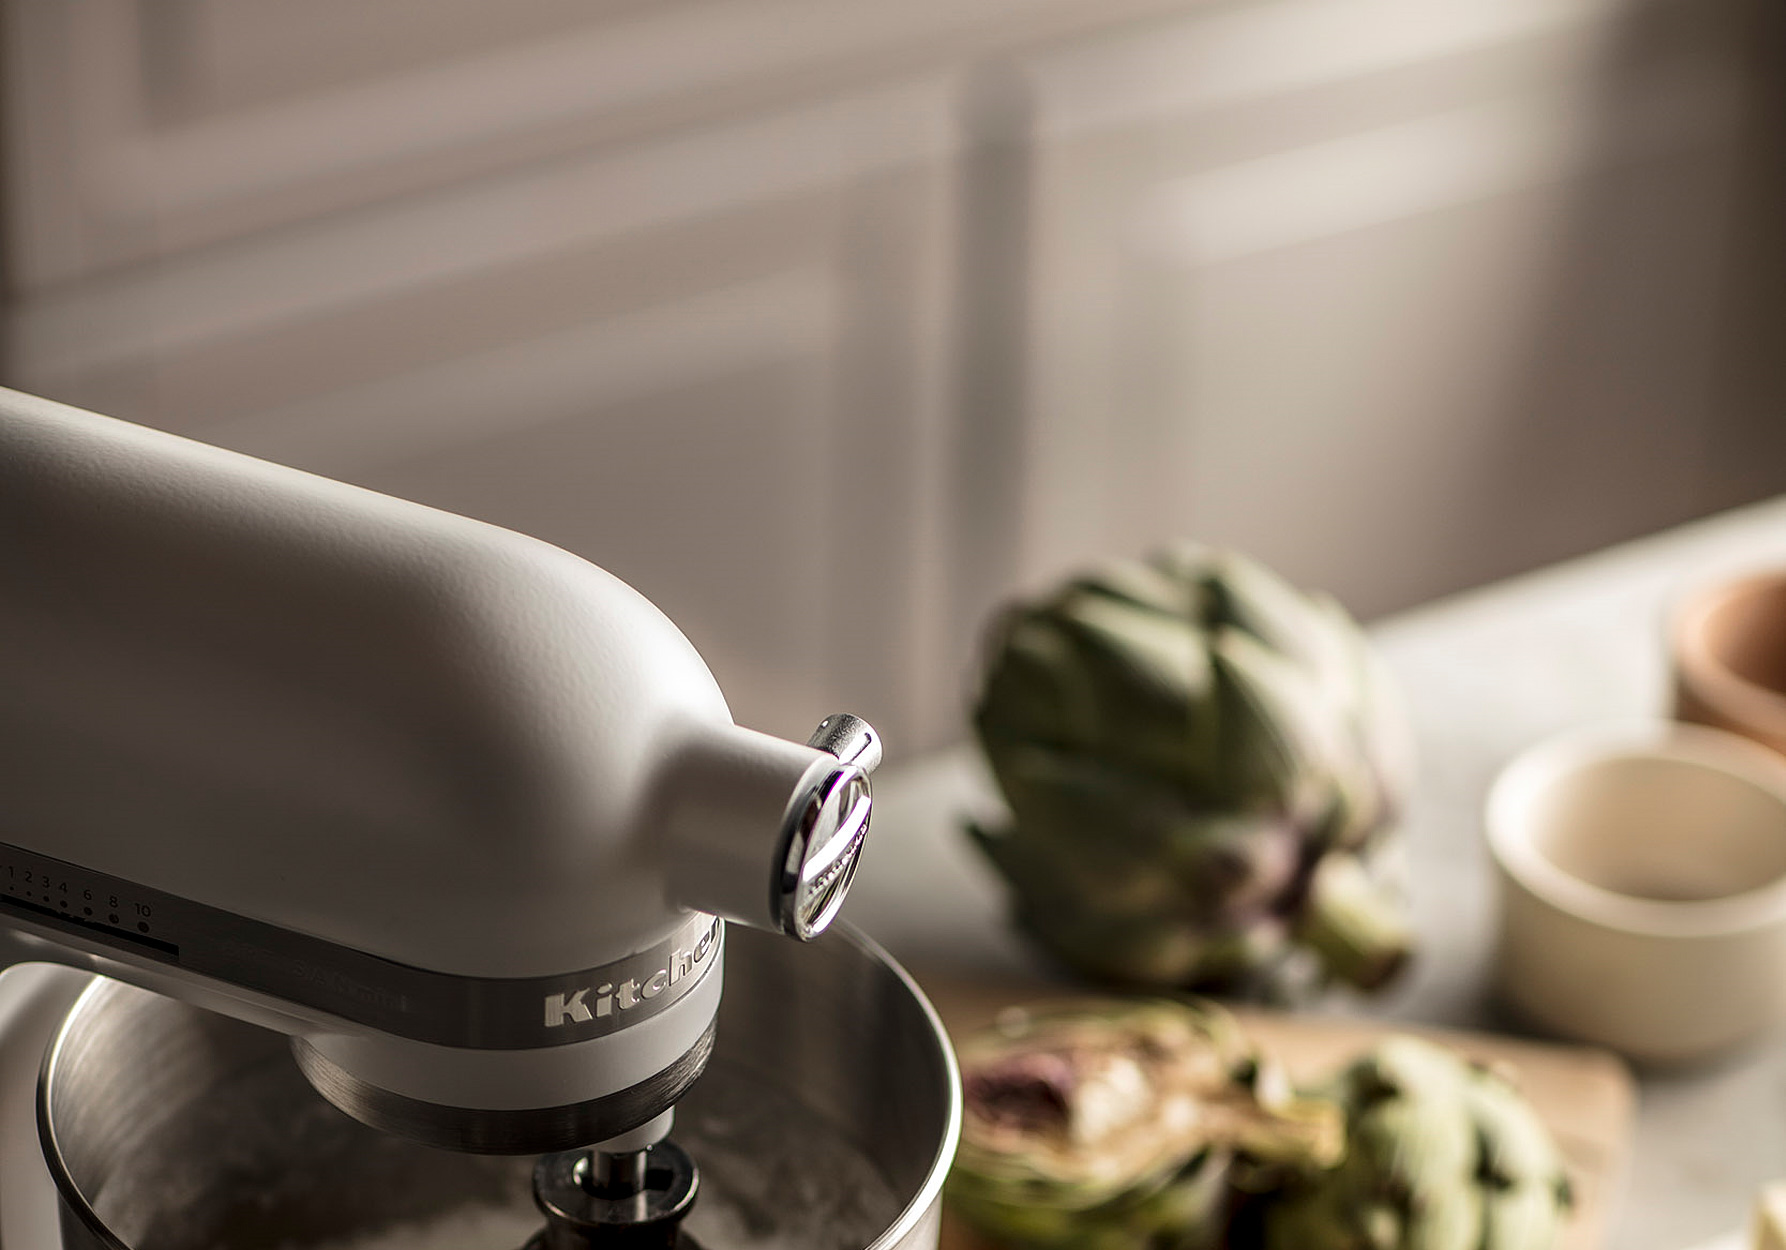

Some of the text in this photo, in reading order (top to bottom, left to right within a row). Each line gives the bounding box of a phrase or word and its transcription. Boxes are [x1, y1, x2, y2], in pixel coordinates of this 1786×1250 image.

[8, 866, 152, 917] 1 2 3 4 6 8 10
